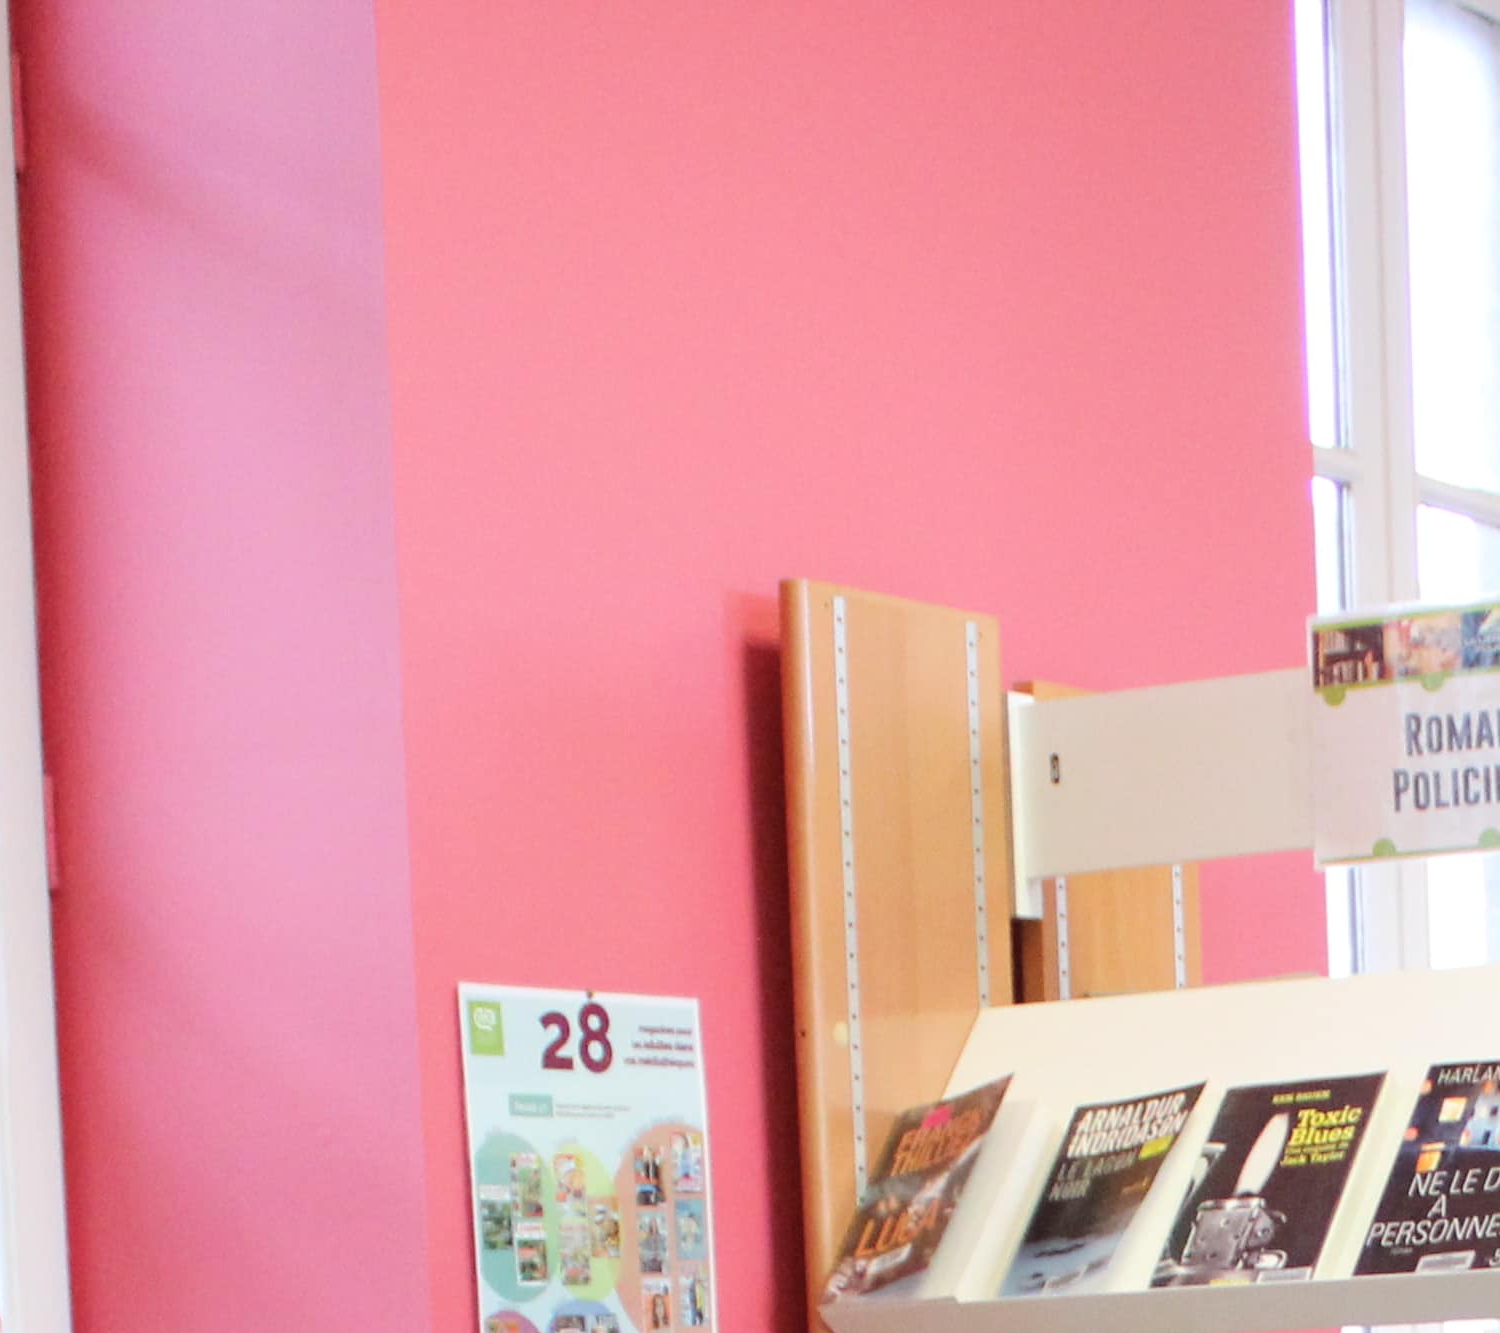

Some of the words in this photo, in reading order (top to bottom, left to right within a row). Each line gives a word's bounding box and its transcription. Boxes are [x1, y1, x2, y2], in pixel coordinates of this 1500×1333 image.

[539, 1002, 614, 1074] 28
[1076, 1092, 1187, 1134] ARNALDUR
[1298, 1104, 1363, 1128] Toxic
[1067, 1111, 1189, 1158] INDRIDASON
[1288, 1125, 1356, 1146] Blues
[1408, 1171, 1452, 1199] NE
[1452, 1168, 1482, 1194] LE
